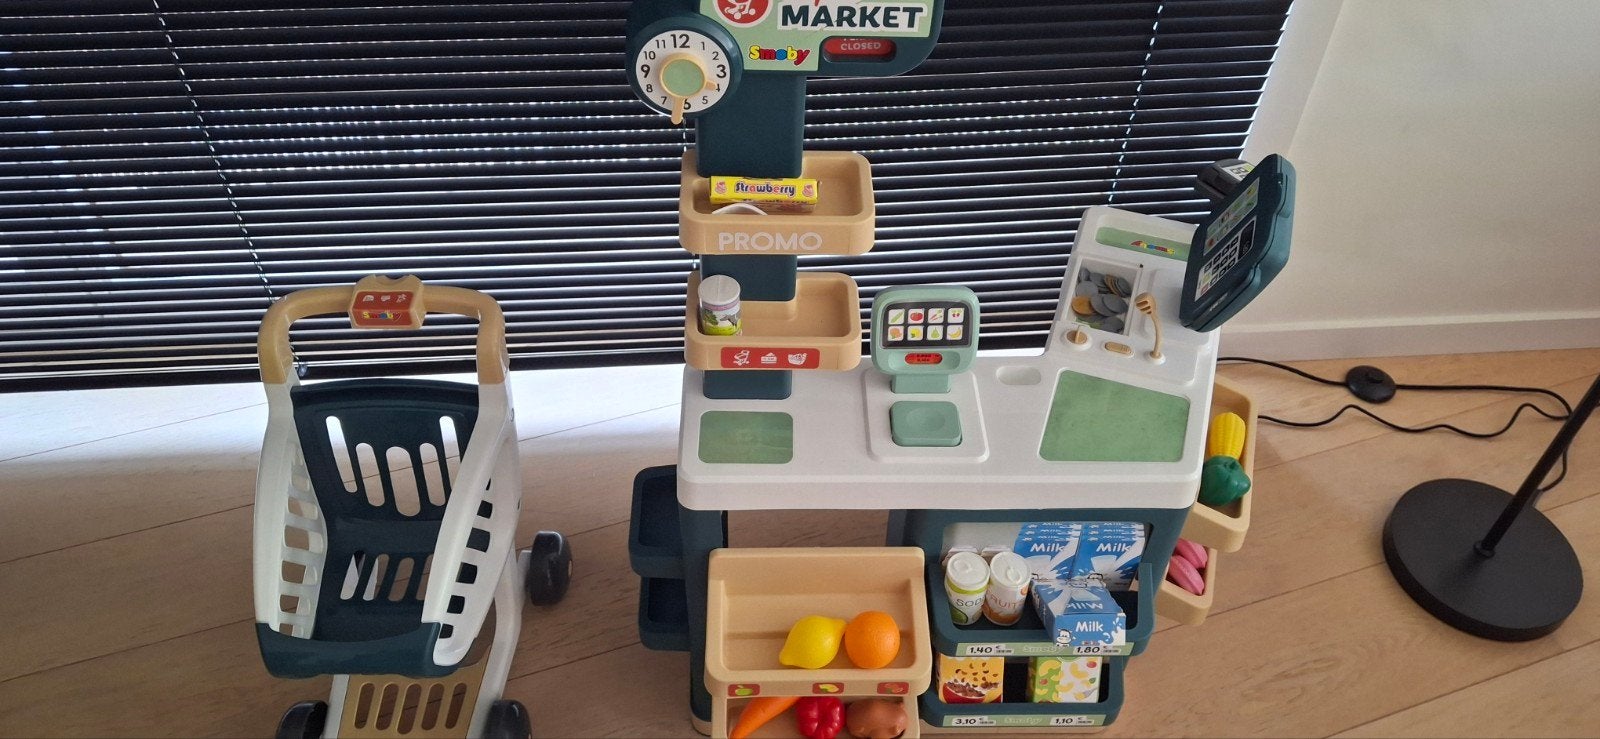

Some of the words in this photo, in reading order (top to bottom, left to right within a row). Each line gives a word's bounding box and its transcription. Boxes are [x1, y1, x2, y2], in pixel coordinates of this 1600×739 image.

[781, 4, 924, 28] MARKET
[656, 39, 666, 49] 11
[670, 34, 690, 48] 12
[701, 42, 706, 50] 1
[840, 42, 882, 51] CLOSED
[644, 50, 656, 60] 10
[712, 51, 719, 60] 2
[748, 46, 811, 66] Smoby
[640, 64, 651, 78] 9
[716, 64, 726, 78] 3
[646, 84, 653, 93] 8
[660, 96, 667, 105] 7
[684, 99, 692, 110] 6
[702, 96, 708, 104] 5
[718, 232, 822, 251] PROMO
[362, 310, 402, 322] Smoby
[1030, 542, 1065, 552] Milk
[1096, 542, 1132, 552] Milk
[1075, 621, 1104, 632] Milk
